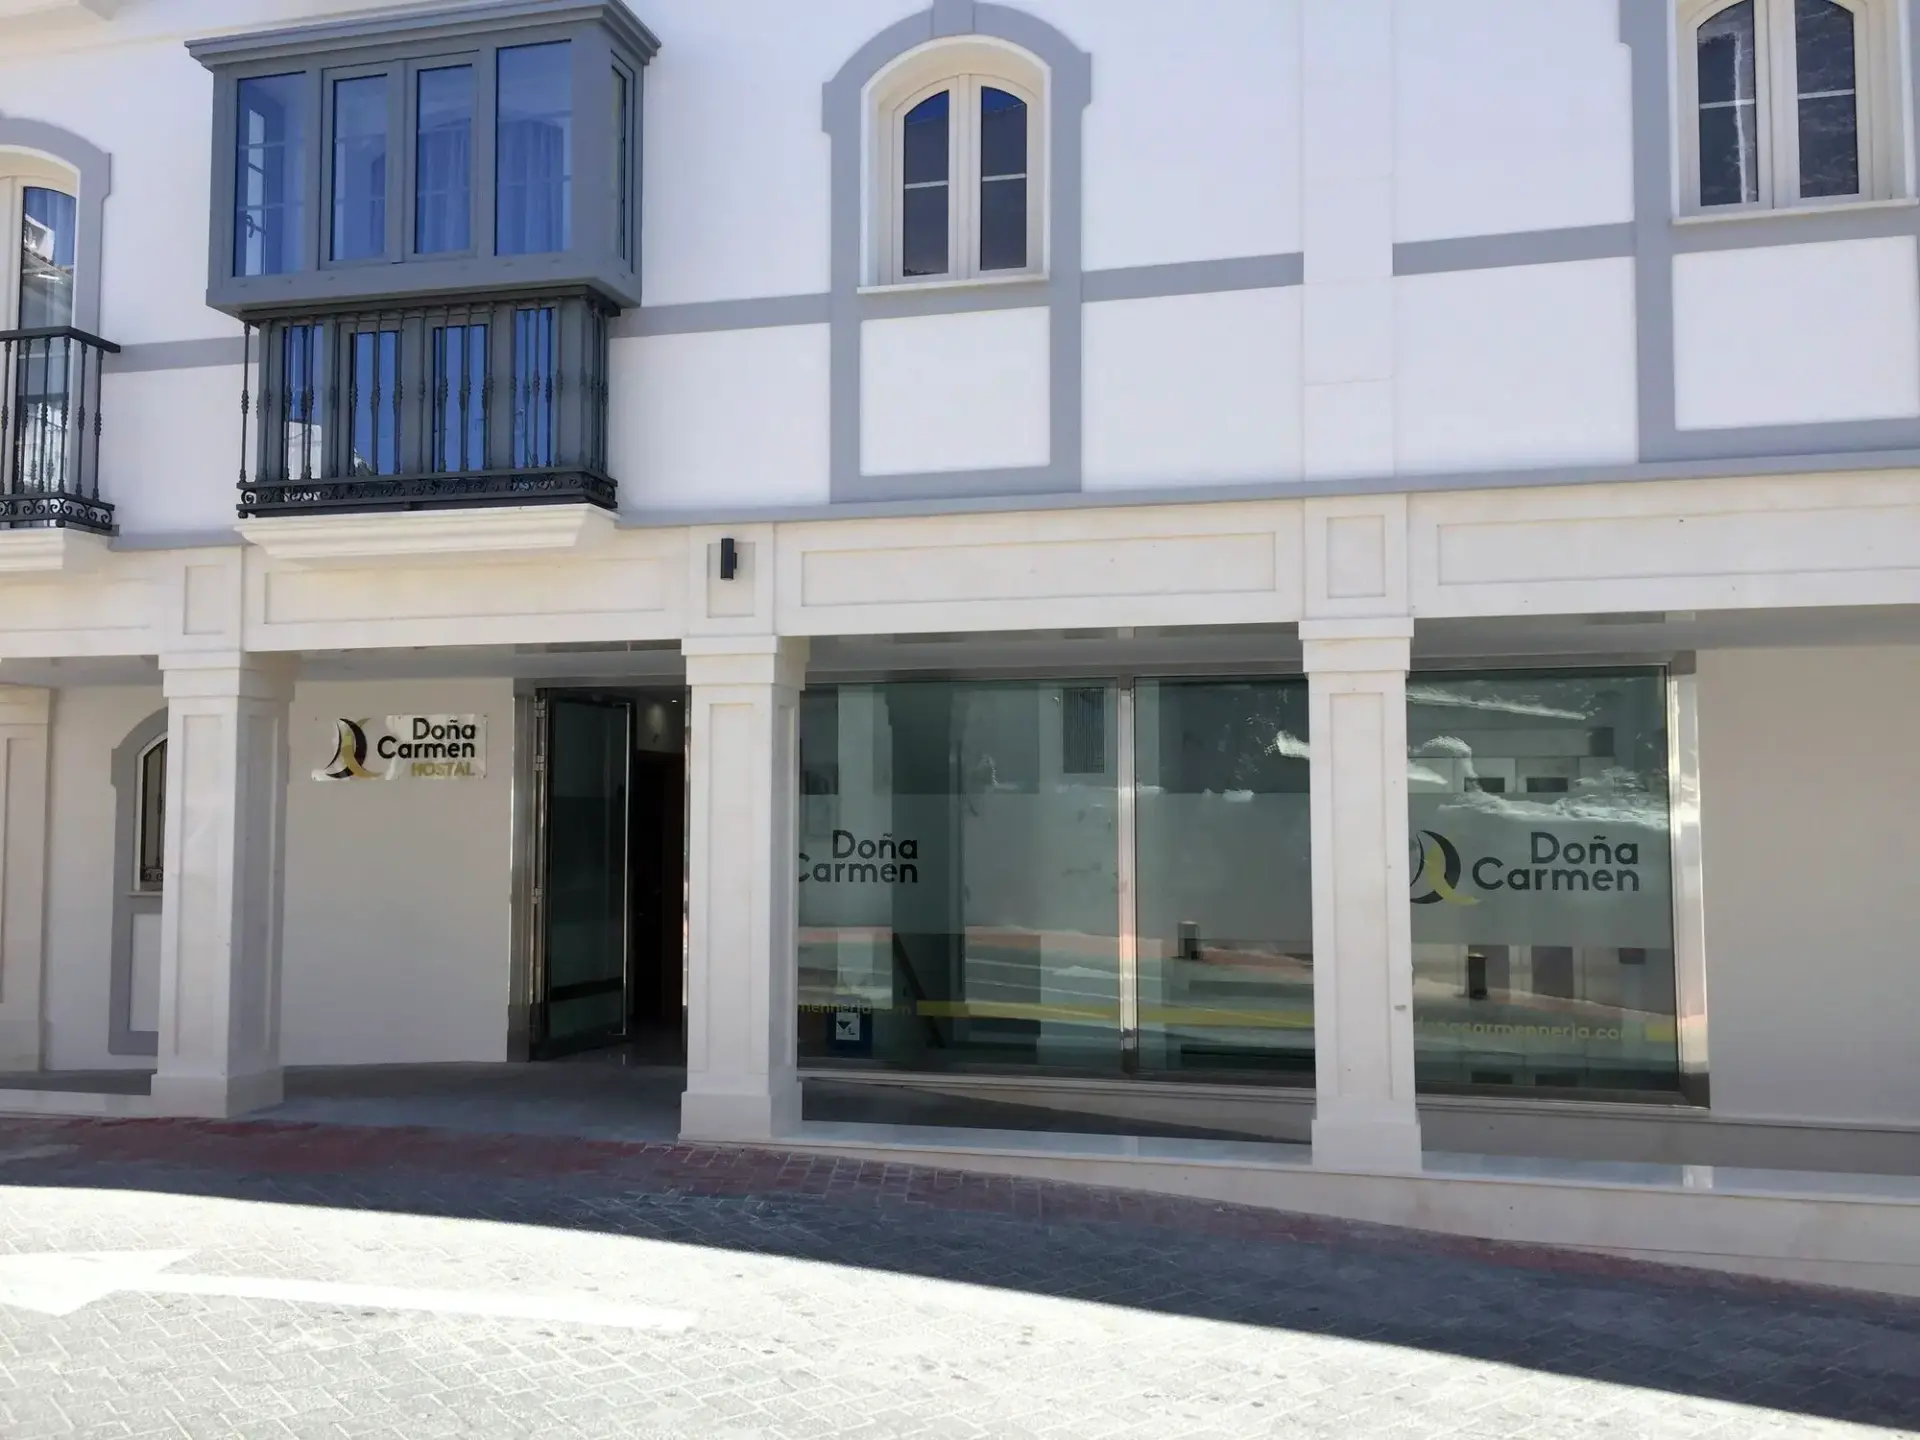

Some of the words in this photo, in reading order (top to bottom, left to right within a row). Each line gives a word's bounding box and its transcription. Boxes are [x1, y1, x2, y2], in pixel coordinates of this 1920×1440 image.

[412, 717, 476, 740] Doña
[377, 735, 475, 759] Carmen
[411, 762, 475, 777] HOSTAL
[832, 829, 918, 859] Doña
[1530, 831, 1639, 865] Doña
[1472, 856, 1640, 892] Carmen
